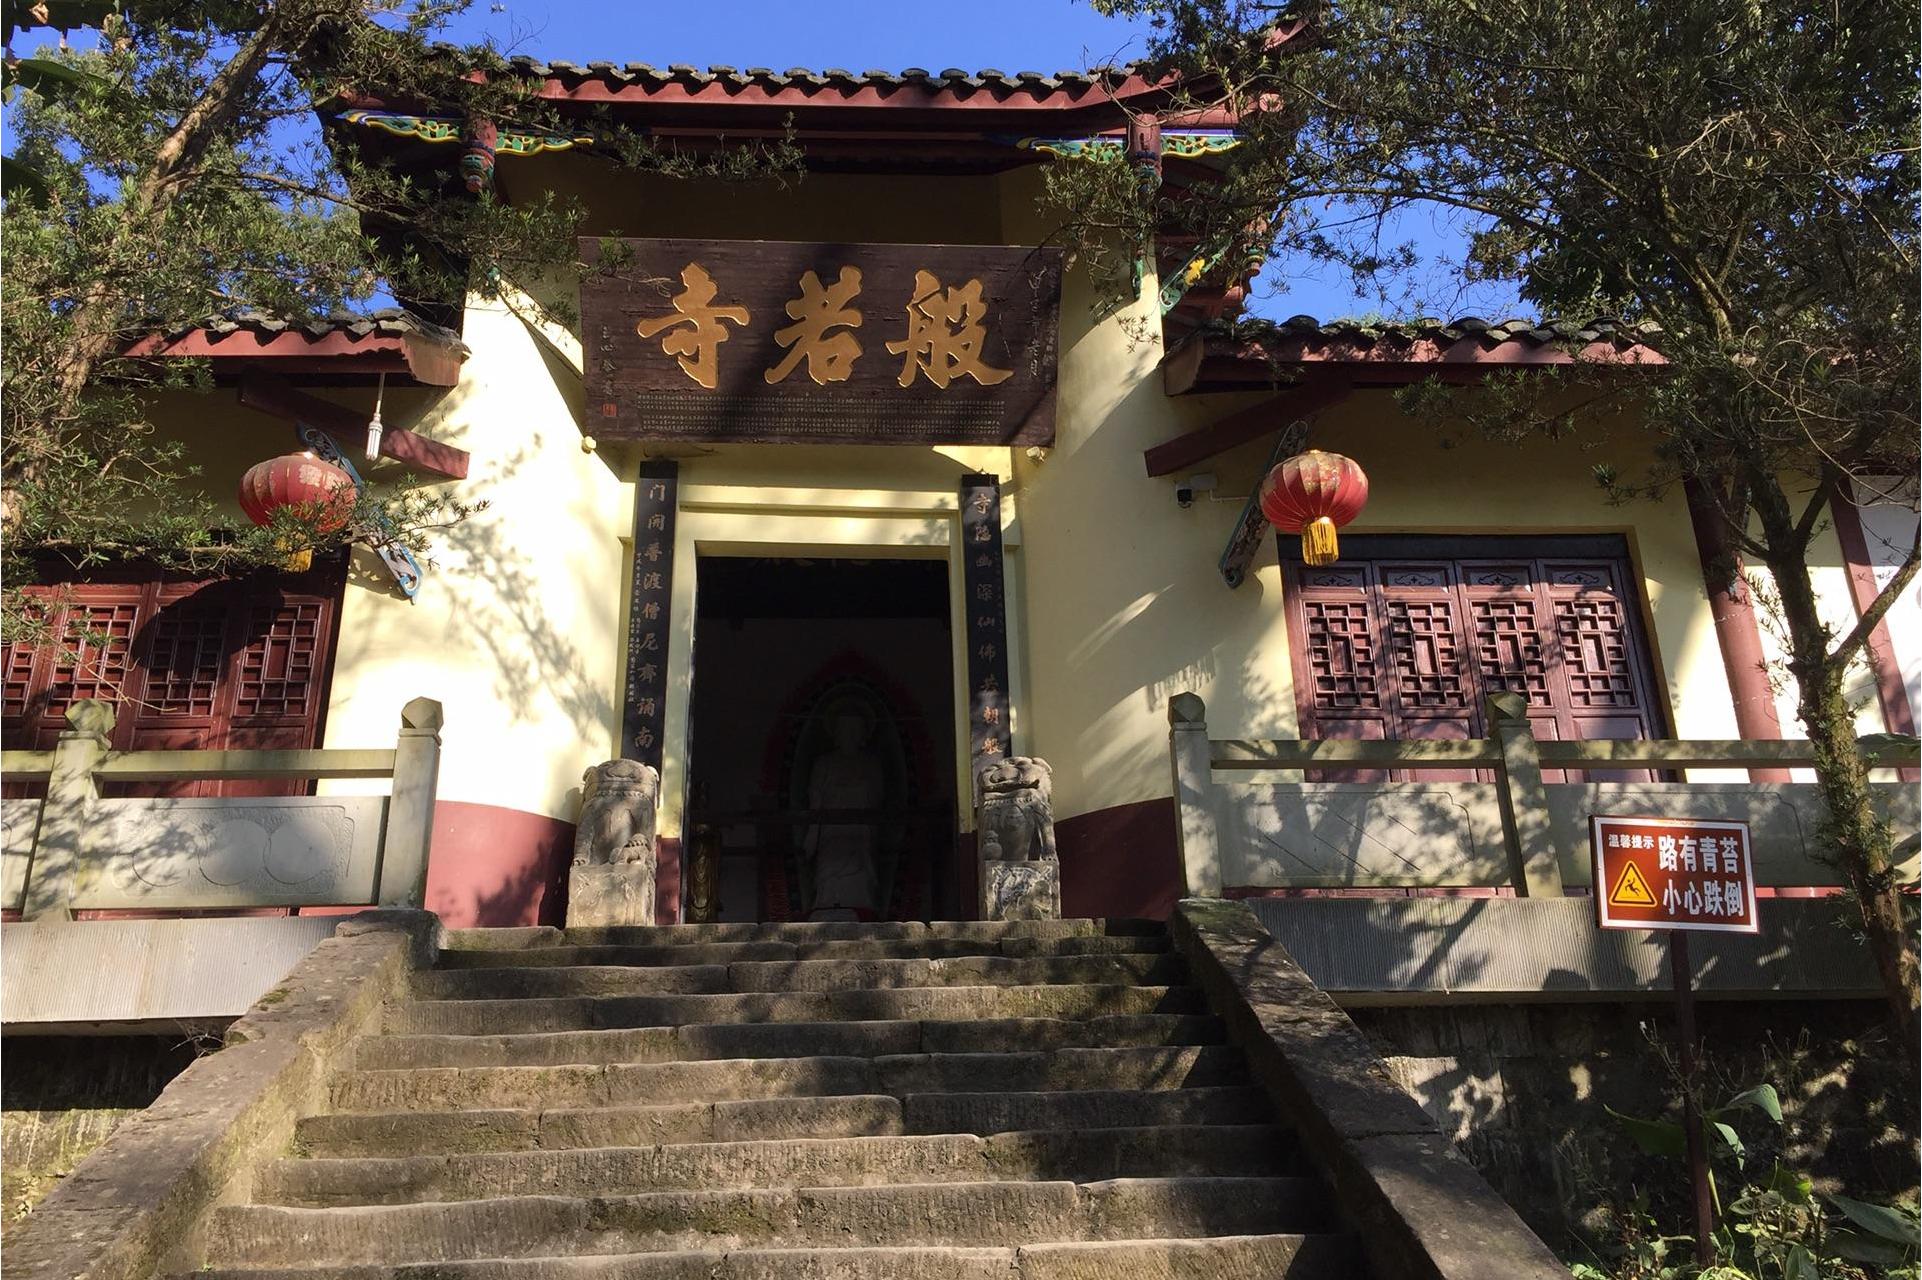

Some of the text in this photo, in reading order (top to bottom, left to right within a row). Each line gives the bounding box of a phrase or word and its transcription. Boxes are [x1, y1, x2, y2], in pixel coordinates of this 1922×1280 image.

[637, 261, 1014, 389] 般若寺
[1608, 833, 1655, 849] 温馨提示
[1658, 834, 1739, 874] 路有青苔
[1662, 878, 1745, 917] 小心跌倒
